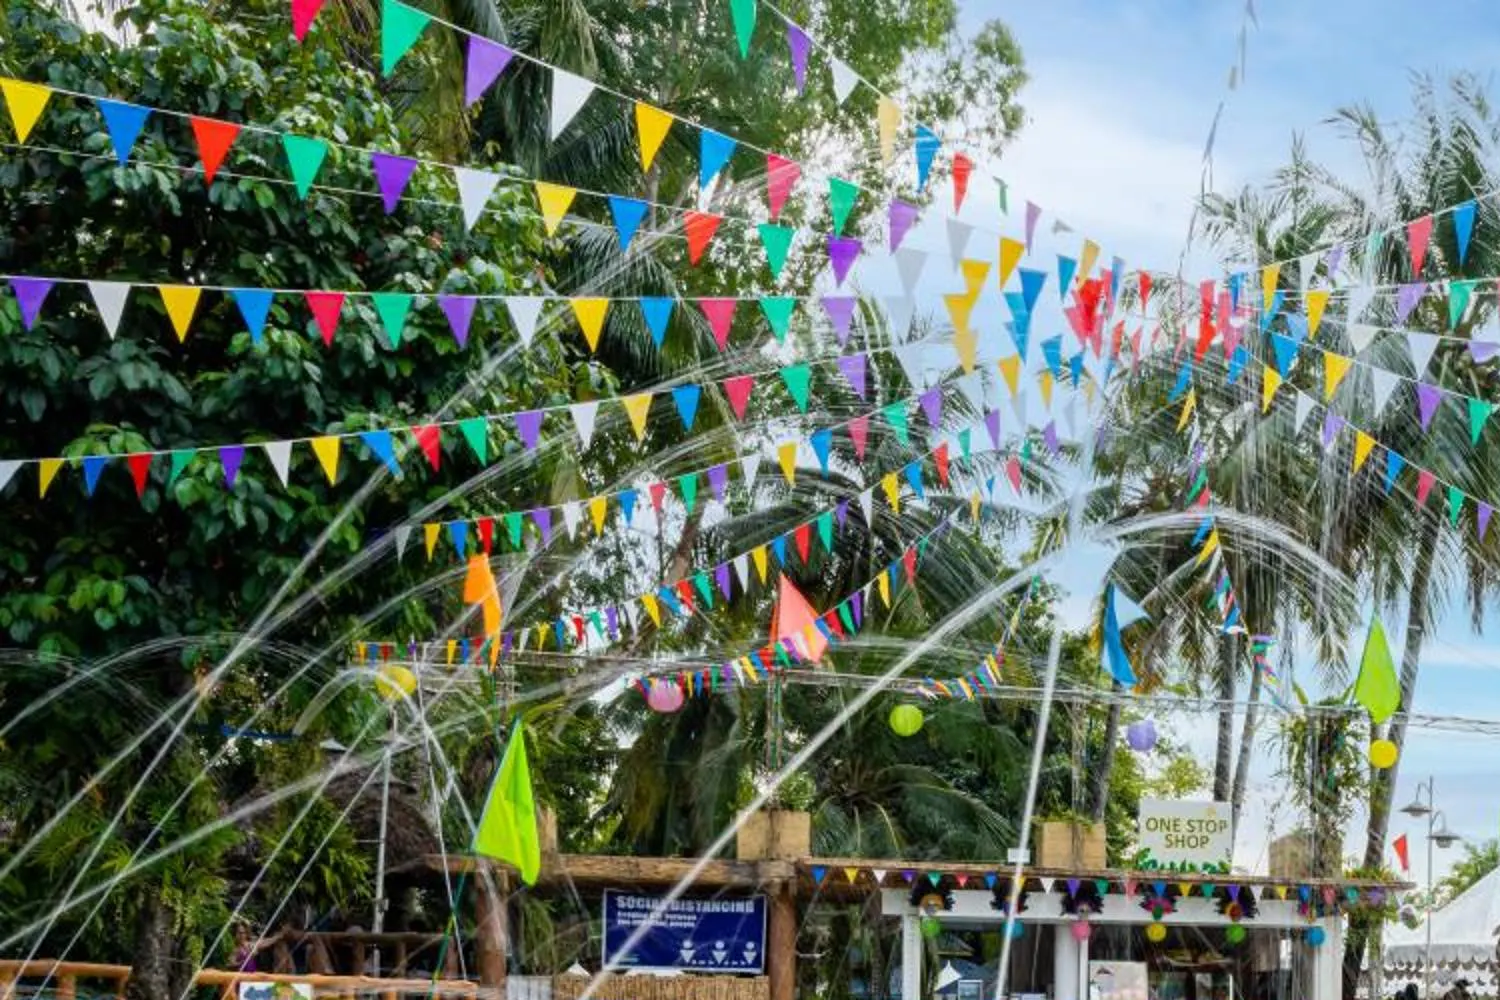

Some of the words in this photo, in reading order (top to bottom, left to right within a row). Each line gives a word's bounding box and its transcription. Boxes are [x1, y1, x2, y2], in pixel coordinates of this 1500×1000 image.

[1145, 817, 1181, 832] ONE
[1187, 819, 1228, 833] STOP
[1164, 833, 1210, 849] SHOP
[671, 899, 755, 913] DISTANCING
